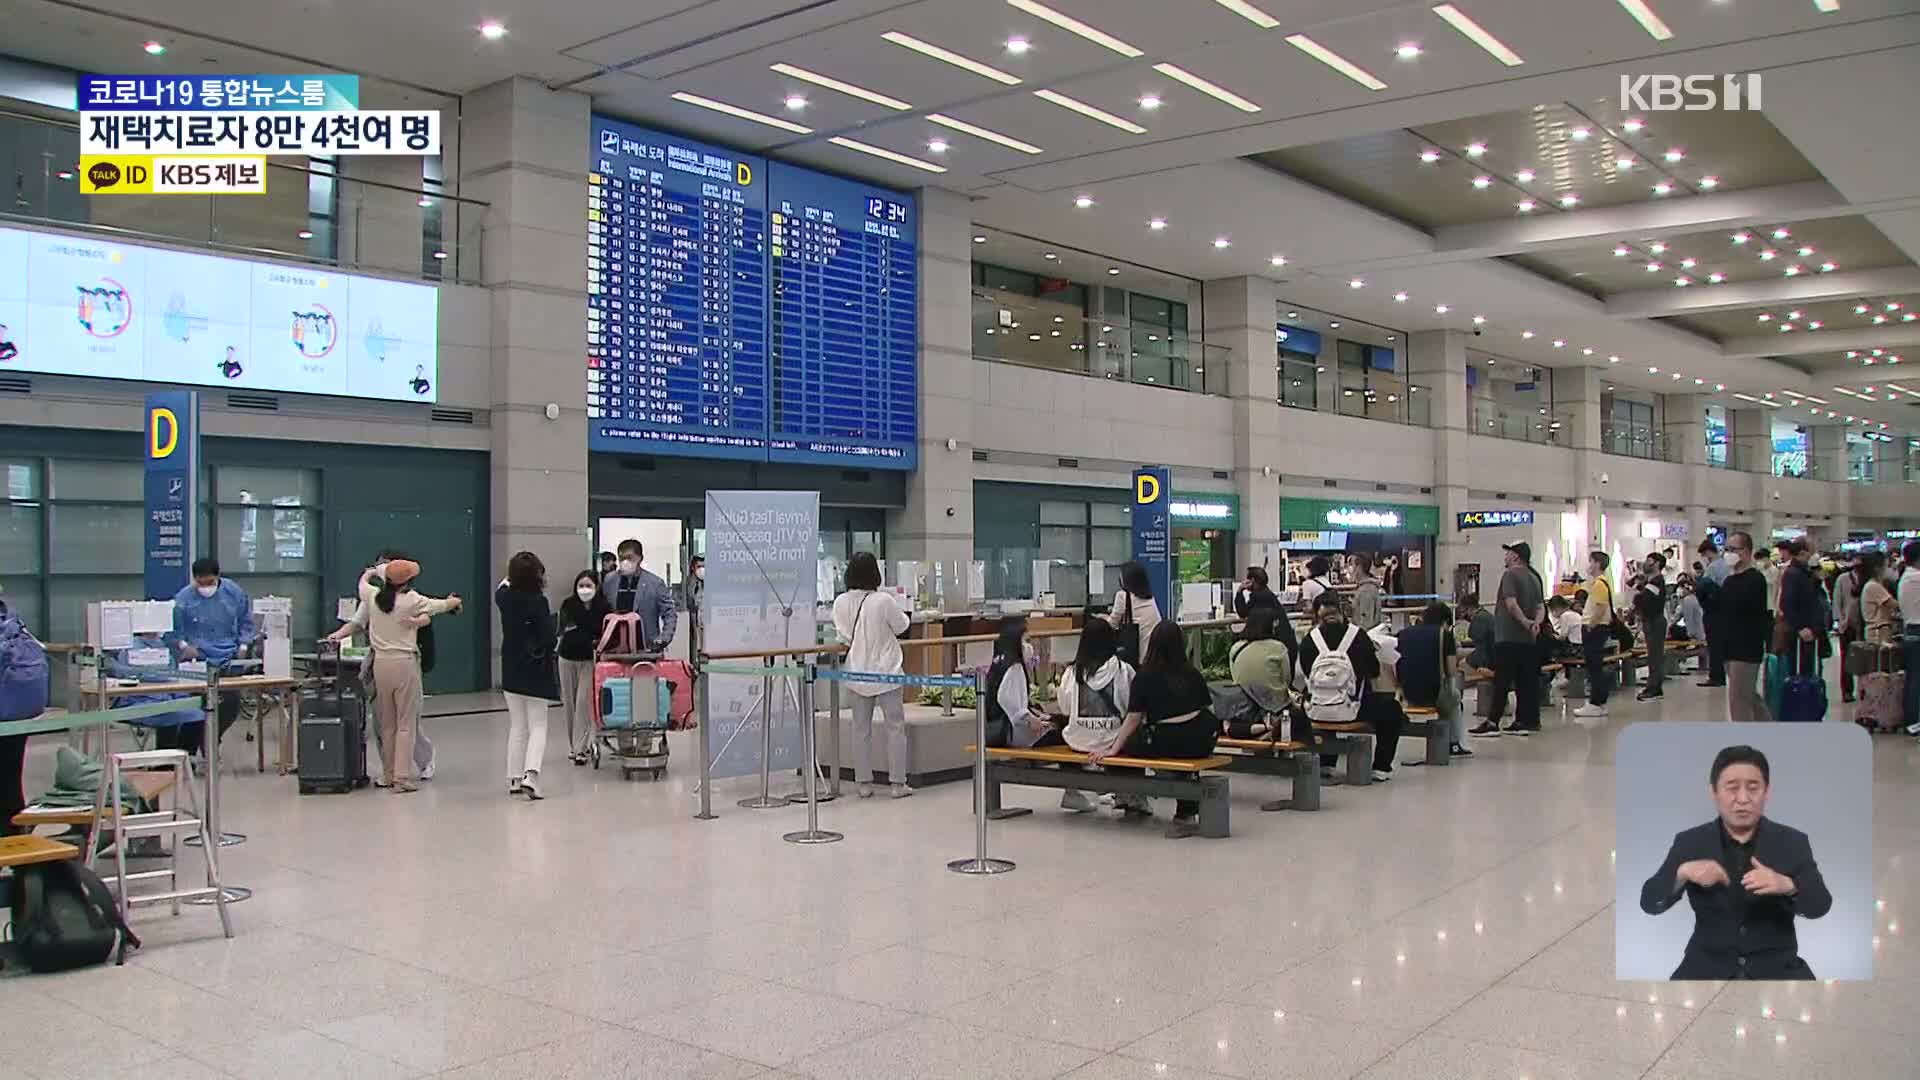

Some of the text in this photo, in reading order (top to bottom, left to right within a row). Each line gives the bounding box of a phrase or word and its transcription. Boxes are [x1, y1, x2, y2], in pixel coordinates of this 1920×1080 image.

[737, 162, 752, 185] D
[869, 199, 906, 222] 12 34
[151, 408, 178, 458] D
[1137, 474, 1160, 504] D
